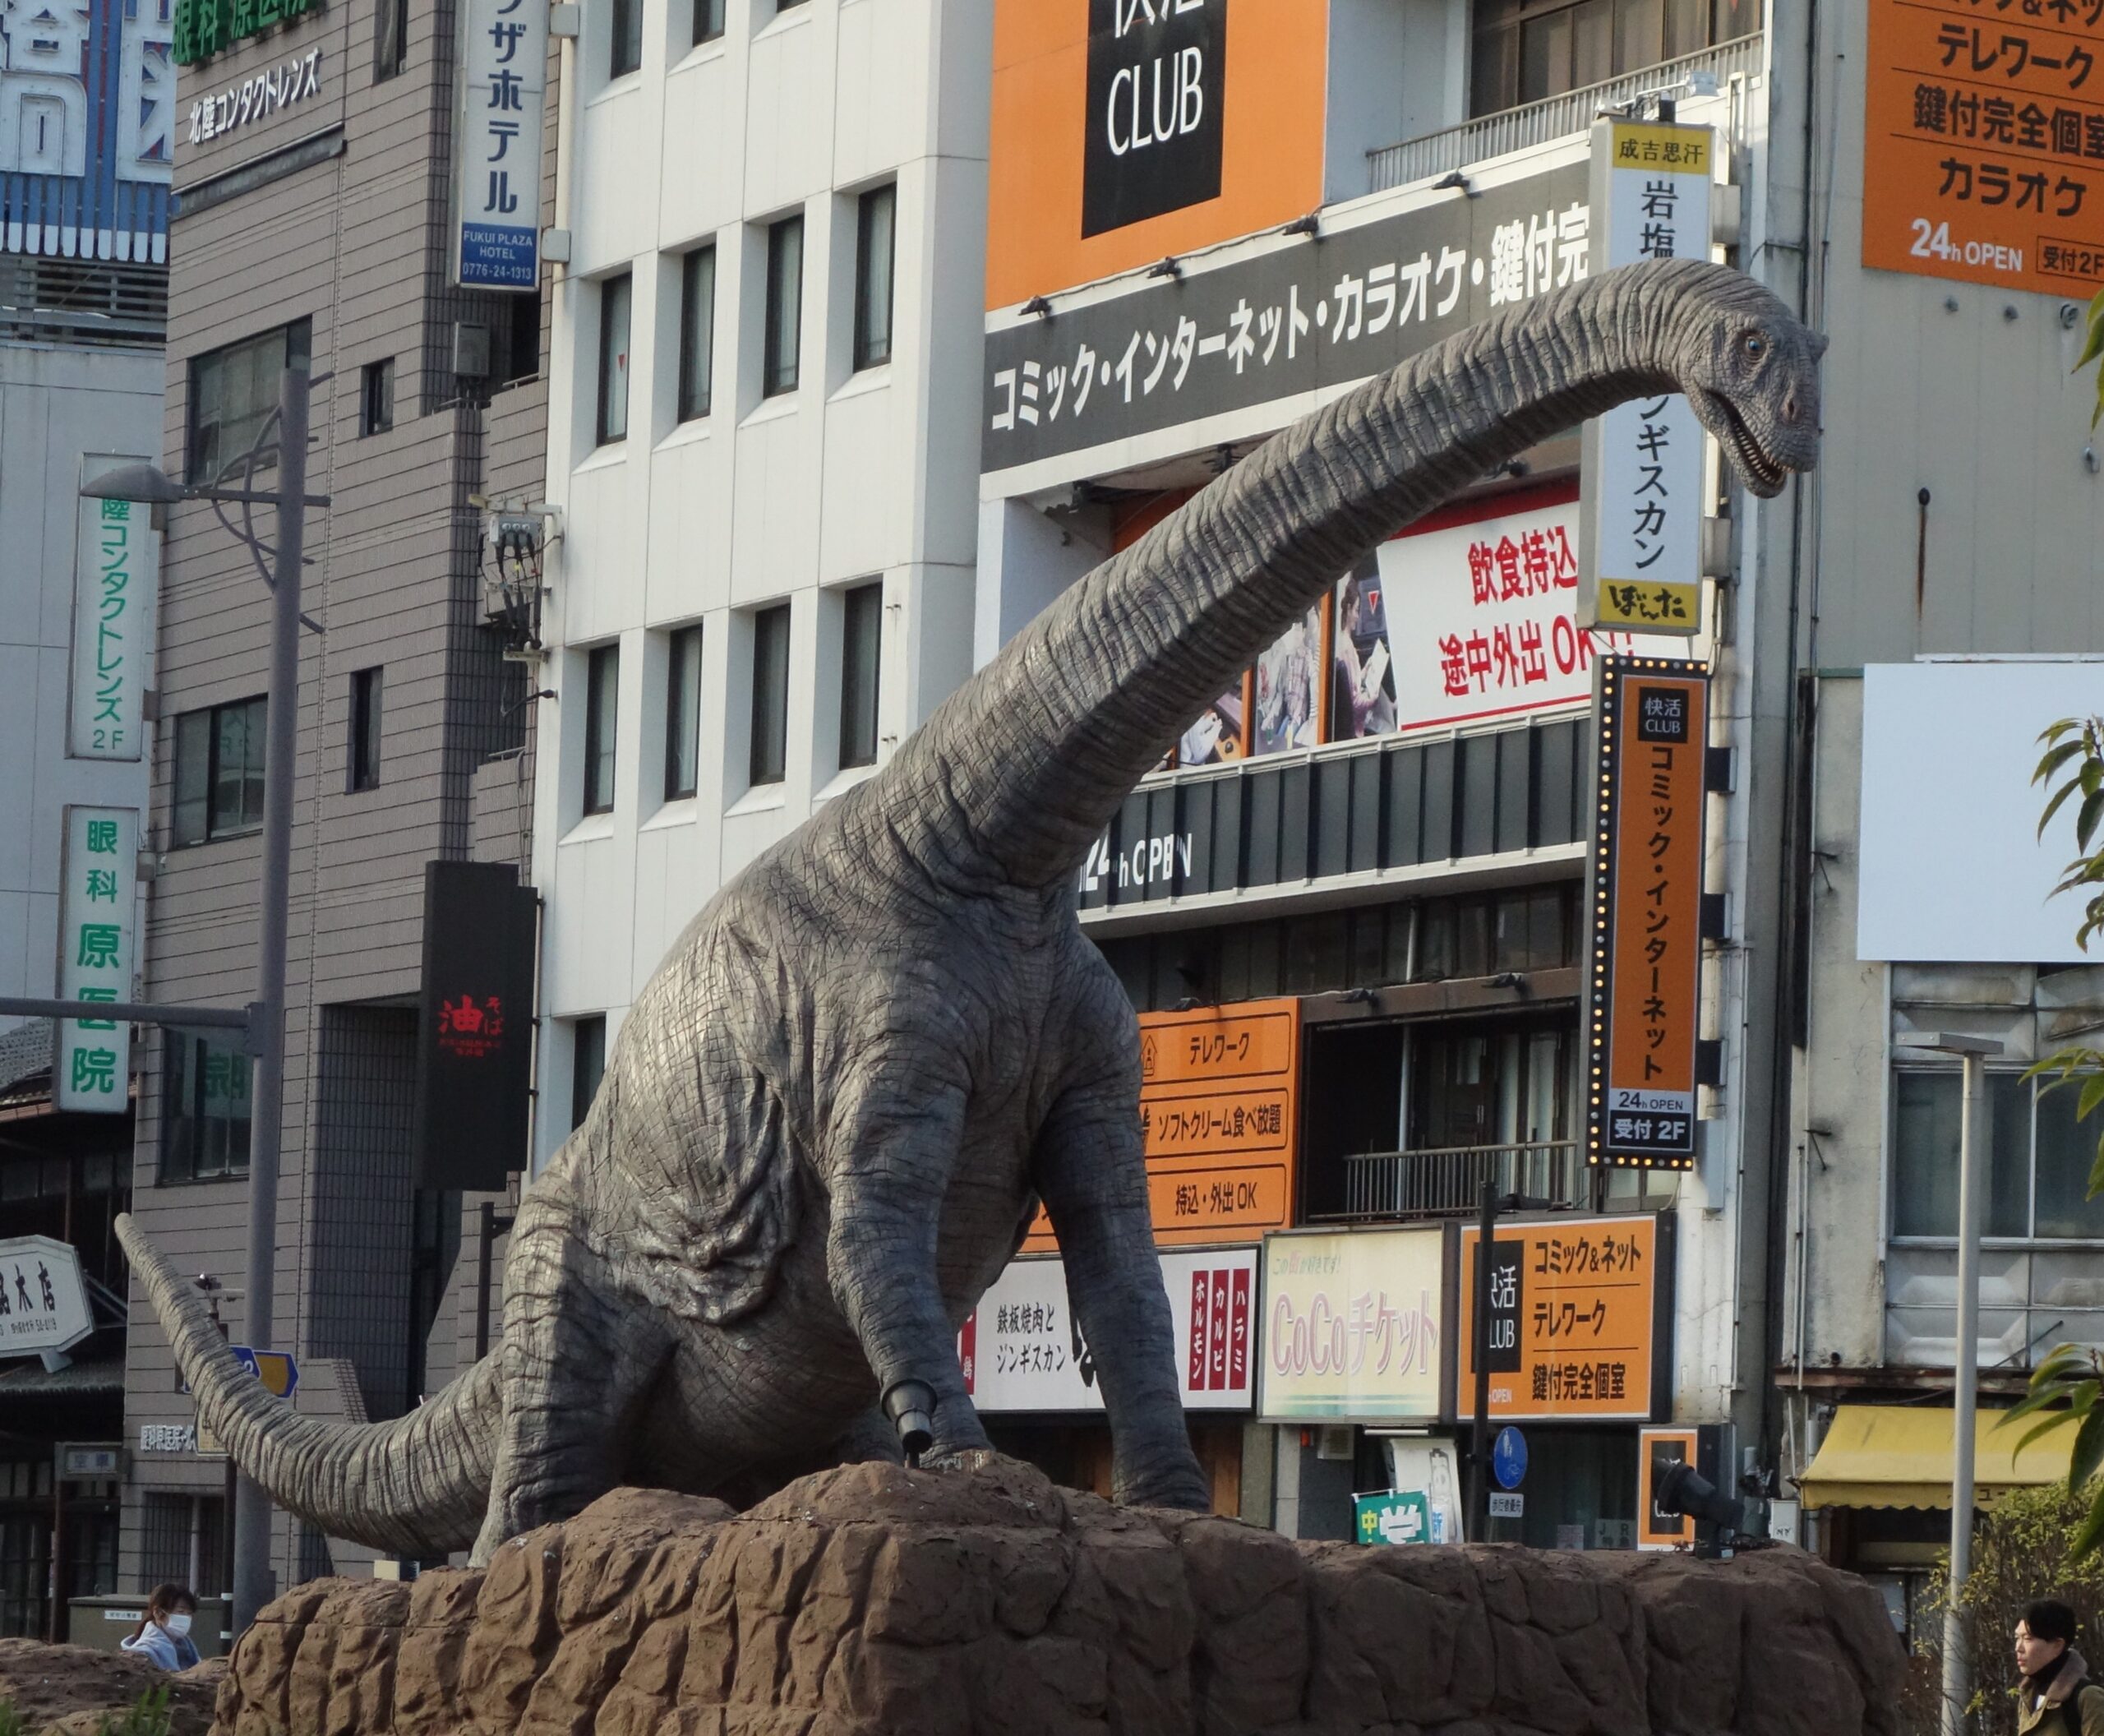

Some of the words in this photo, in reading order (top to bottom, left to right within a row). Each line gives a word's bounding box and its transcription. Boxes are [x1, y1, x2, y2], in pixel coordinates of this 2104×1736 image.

[1938, 23, 2093, 90] テレワーク
[188, 47, 323, 145] 北陸コンタクトレンズ
[1107, 47, 1203, 155] CLUB
[1619, 138, 1705, 164] 成吉思汗
[1939, 157, 2088, 217] カラオケ
[464, 230, 496, 245] FUKUI
[498, 233, 533, 247] PLAZA
[479, 245, 515, 260] HOTEL
[462, 261, 532, 279] 0776-24-1313
[1965, 241, 2023, 272] OPEN
[93, 498, 130, 723] 陸コンタクトレンズ
[1645, 697, 1682, 718] 快活
[1645, 718, 1682, 734] CLUB
[1190, 1032, 1250, 1066] テレワーク
[1650, 1099, 1684, 1110] OPEN
[1159, 1103, 1281, 1143] ソフトクリーム食べ放題
[997, 1301, 1055, 1335] 鉄板焼肉と
[1192, 1279, 1206, 1380] ホルモン
[1213, 1287, 1225, 1373] カルビ
[1234, 1292, 1246, 1374] ハラミ
[1489, 1318, 1515, 1349] LUB
[1534, 1299, 1607, 1338] テレワーク
[997, 1343, 1066, 1374] ジンギスカン
[1531, 1362, 1626, 1401] 鍵付完全個室
